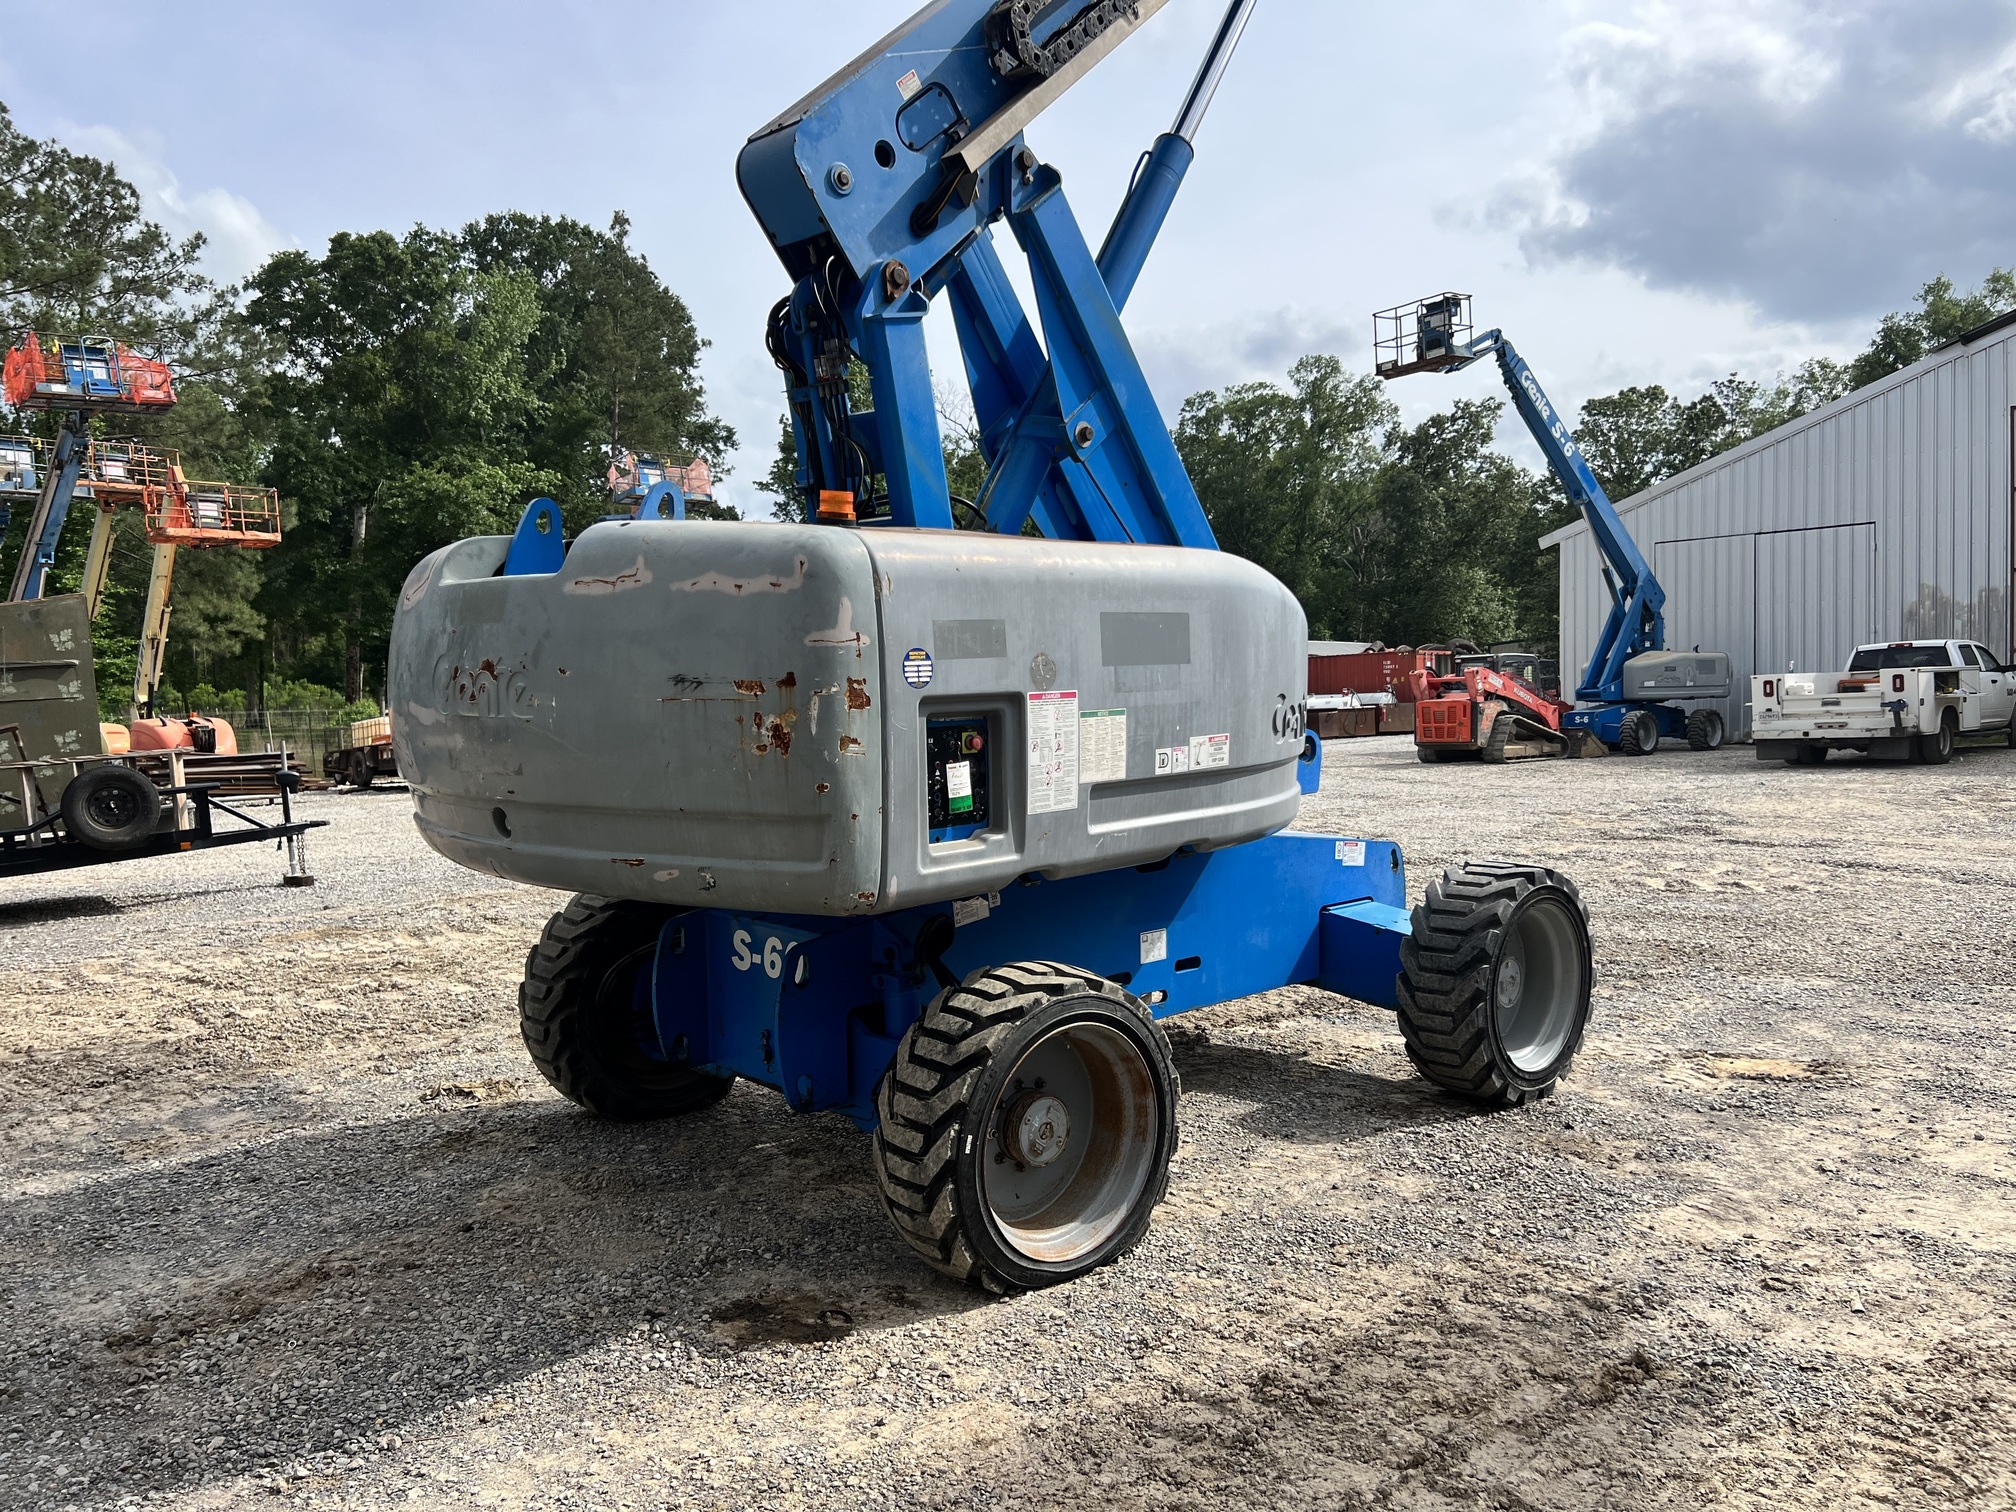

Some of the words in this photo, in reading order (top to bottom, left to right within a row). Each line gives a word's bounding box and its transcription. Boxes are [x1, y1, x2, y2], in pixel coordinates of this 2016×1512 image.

[1521, 370, 1550, 420] Genie
[1551, 421, 1576, 457] S-6
[1513, 687, 1533, 704] KUBOTA
[1574, 715, 1589, 724] S-6
